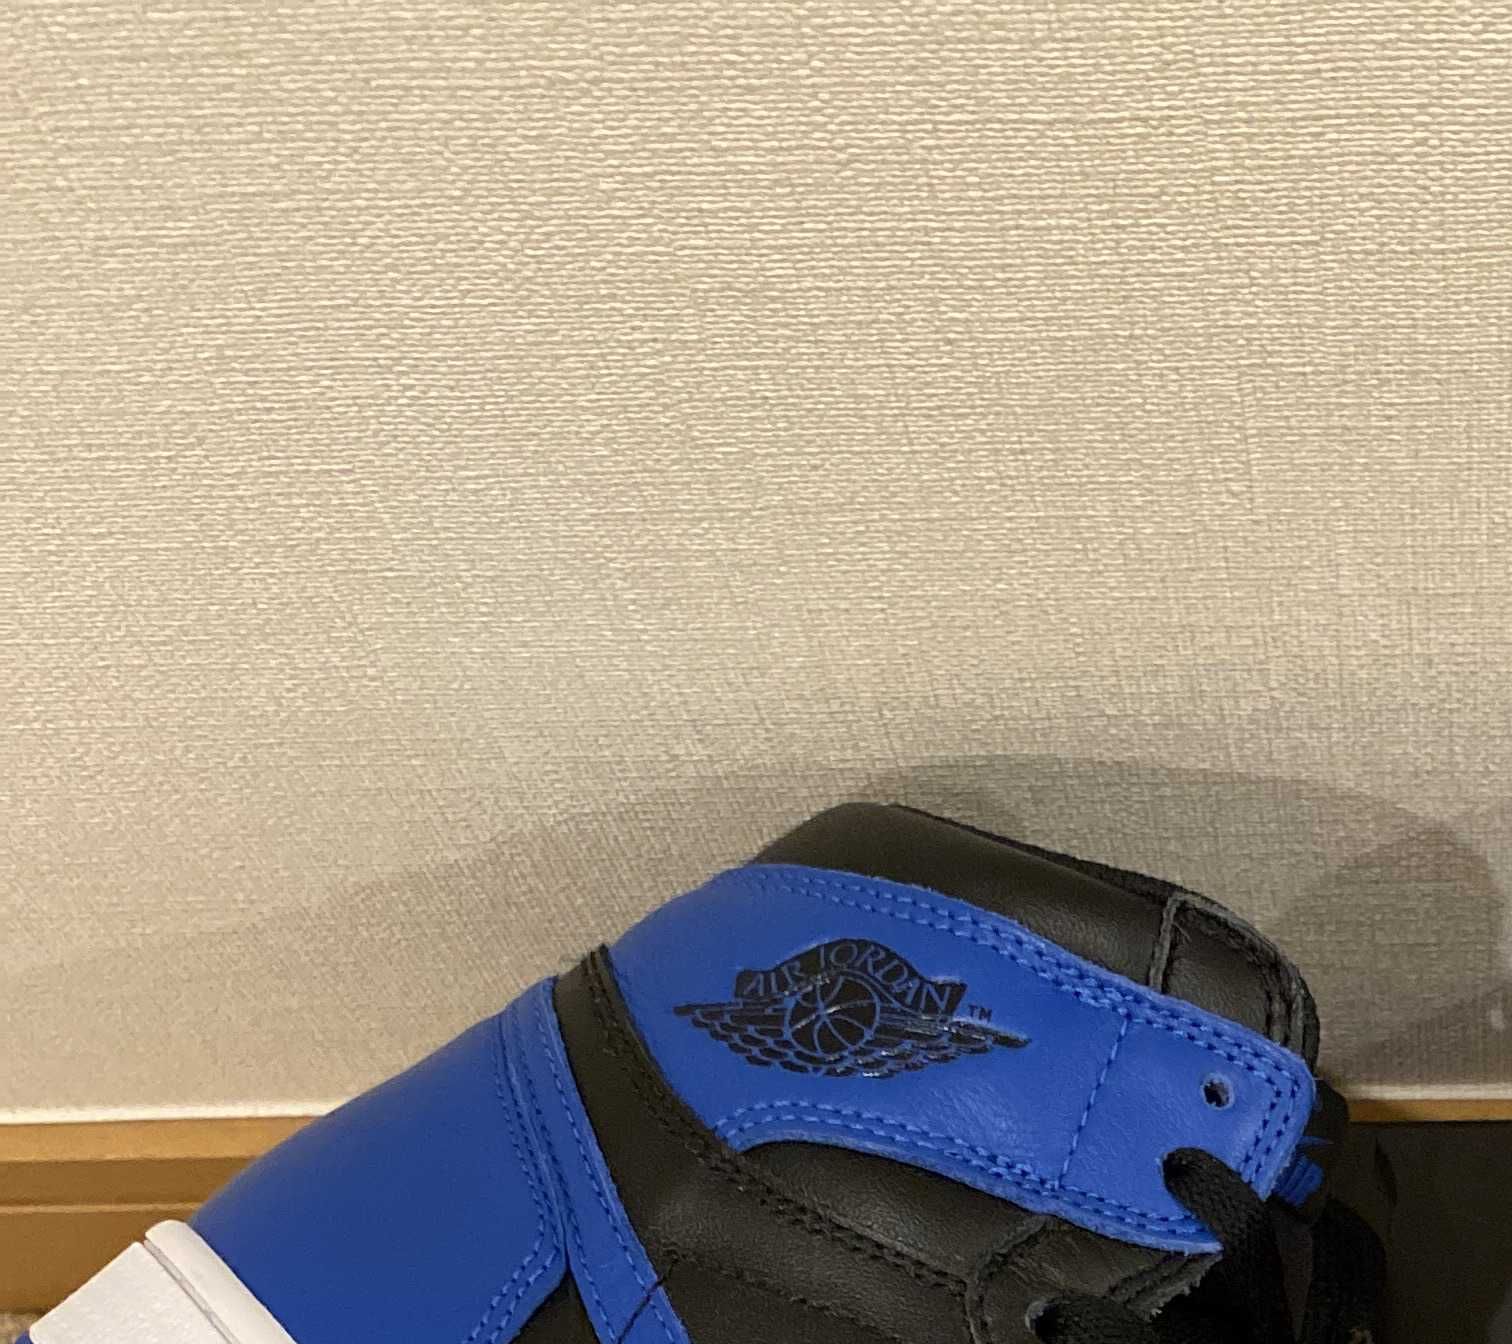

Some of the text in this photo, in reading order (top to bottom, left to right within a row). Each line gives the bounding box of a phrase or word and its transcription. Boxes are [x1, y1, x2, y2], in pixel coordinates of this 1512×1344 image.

[744, 942, 951, 1017] AIR JORDAN
[968, 1004, 993, 1022] TM
